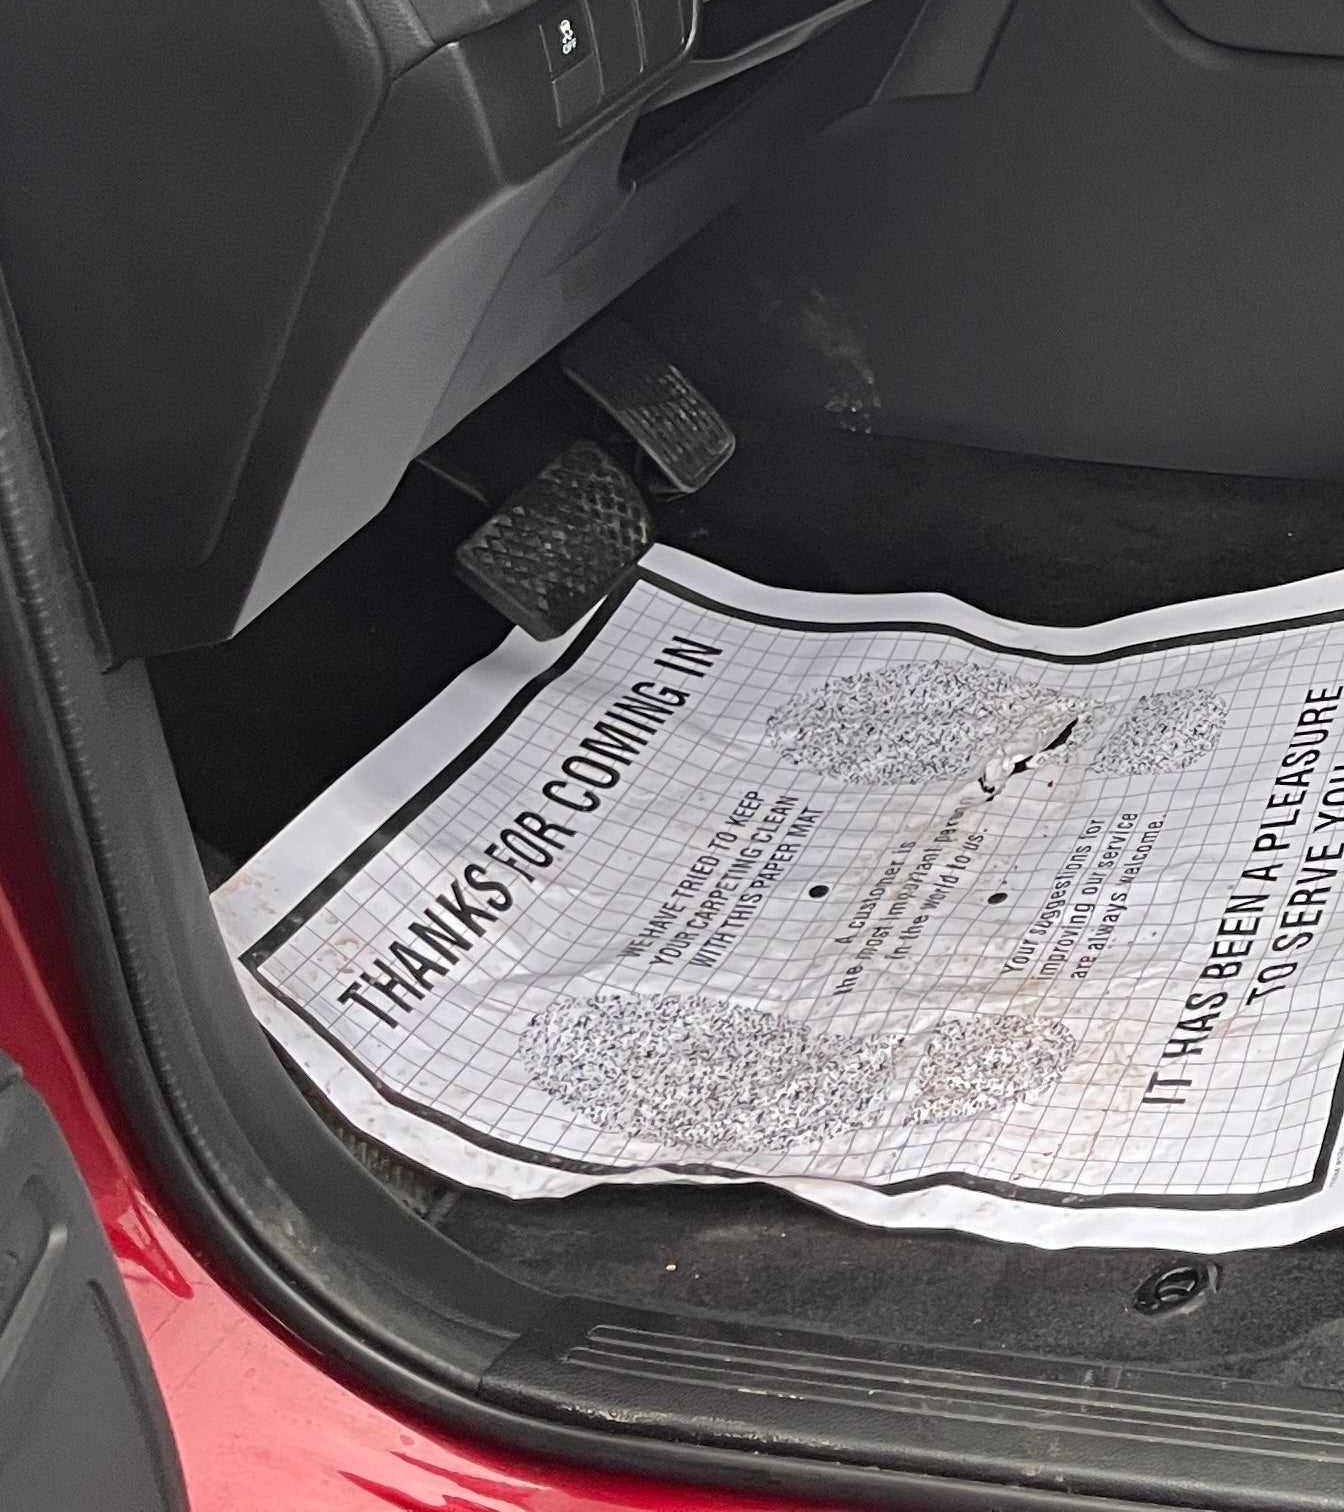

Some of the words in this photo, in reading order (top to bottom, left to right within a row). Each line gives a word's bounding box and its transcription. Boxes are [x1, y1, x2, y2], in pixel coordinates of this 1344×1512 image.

[337, 864, 513, 1029] THANKS
[485, 811, 576, 882] FOR
[542, 681, 690, 812] COMING
[654, 636, 722, 677] IN
[1252, 685, 1344, 853] PLEASURE
[616, 939, 653, 958] WE
[639, 901, 685, 940] HAVE
[672, 855, 720, 898] TRIED
[708, 831, 738, 851] TO
[725, 791, 764, 827] KEEP
[649, 931, 695, 966] YOUR
[687, 847, 763, 929] CARPETING
[752, 795, 799, 844] CLEAN
[688, 931, 734, 969] WITH
[720, 893, 763, 933] THIS
[749, 843, 801, 889] PAPER
[789, 806, 824, 838] MAT
[832, 963, 863, 996] the
[855, 925, 894, 960] most
[878, 848, 943, 921] important
[834, 934, 857, 944] A
[848, 860, 905, 929] customer
[891, 841, 917, 854] is
[898, 914, 929, 940] the
[920, 874, 960, 910] world
[947, 854, 971, 872] to
[1000, 939, 1039, 975] Your
[1029, 844, 1092, 936] suggestions
[1079, 819, 1105, 840] for
[1031, 903, 1096, 980] improving
[1082, 871, 1107, 896] our
[1098, 813, 1138, 868] service
[1071, 955, 1098, 979] are
[1088, 892, 1128, 951] always
[1115, 813, 1167, 886] welcome.
[1200, 895, 1271, 979] BEEN
[1241, 862, 1284, 883] A
[1162, 991, 1229, 1059] HAS
[1246, 961, 1298, 1007] TO
[1141, 1071, 1193, 1105] IT
